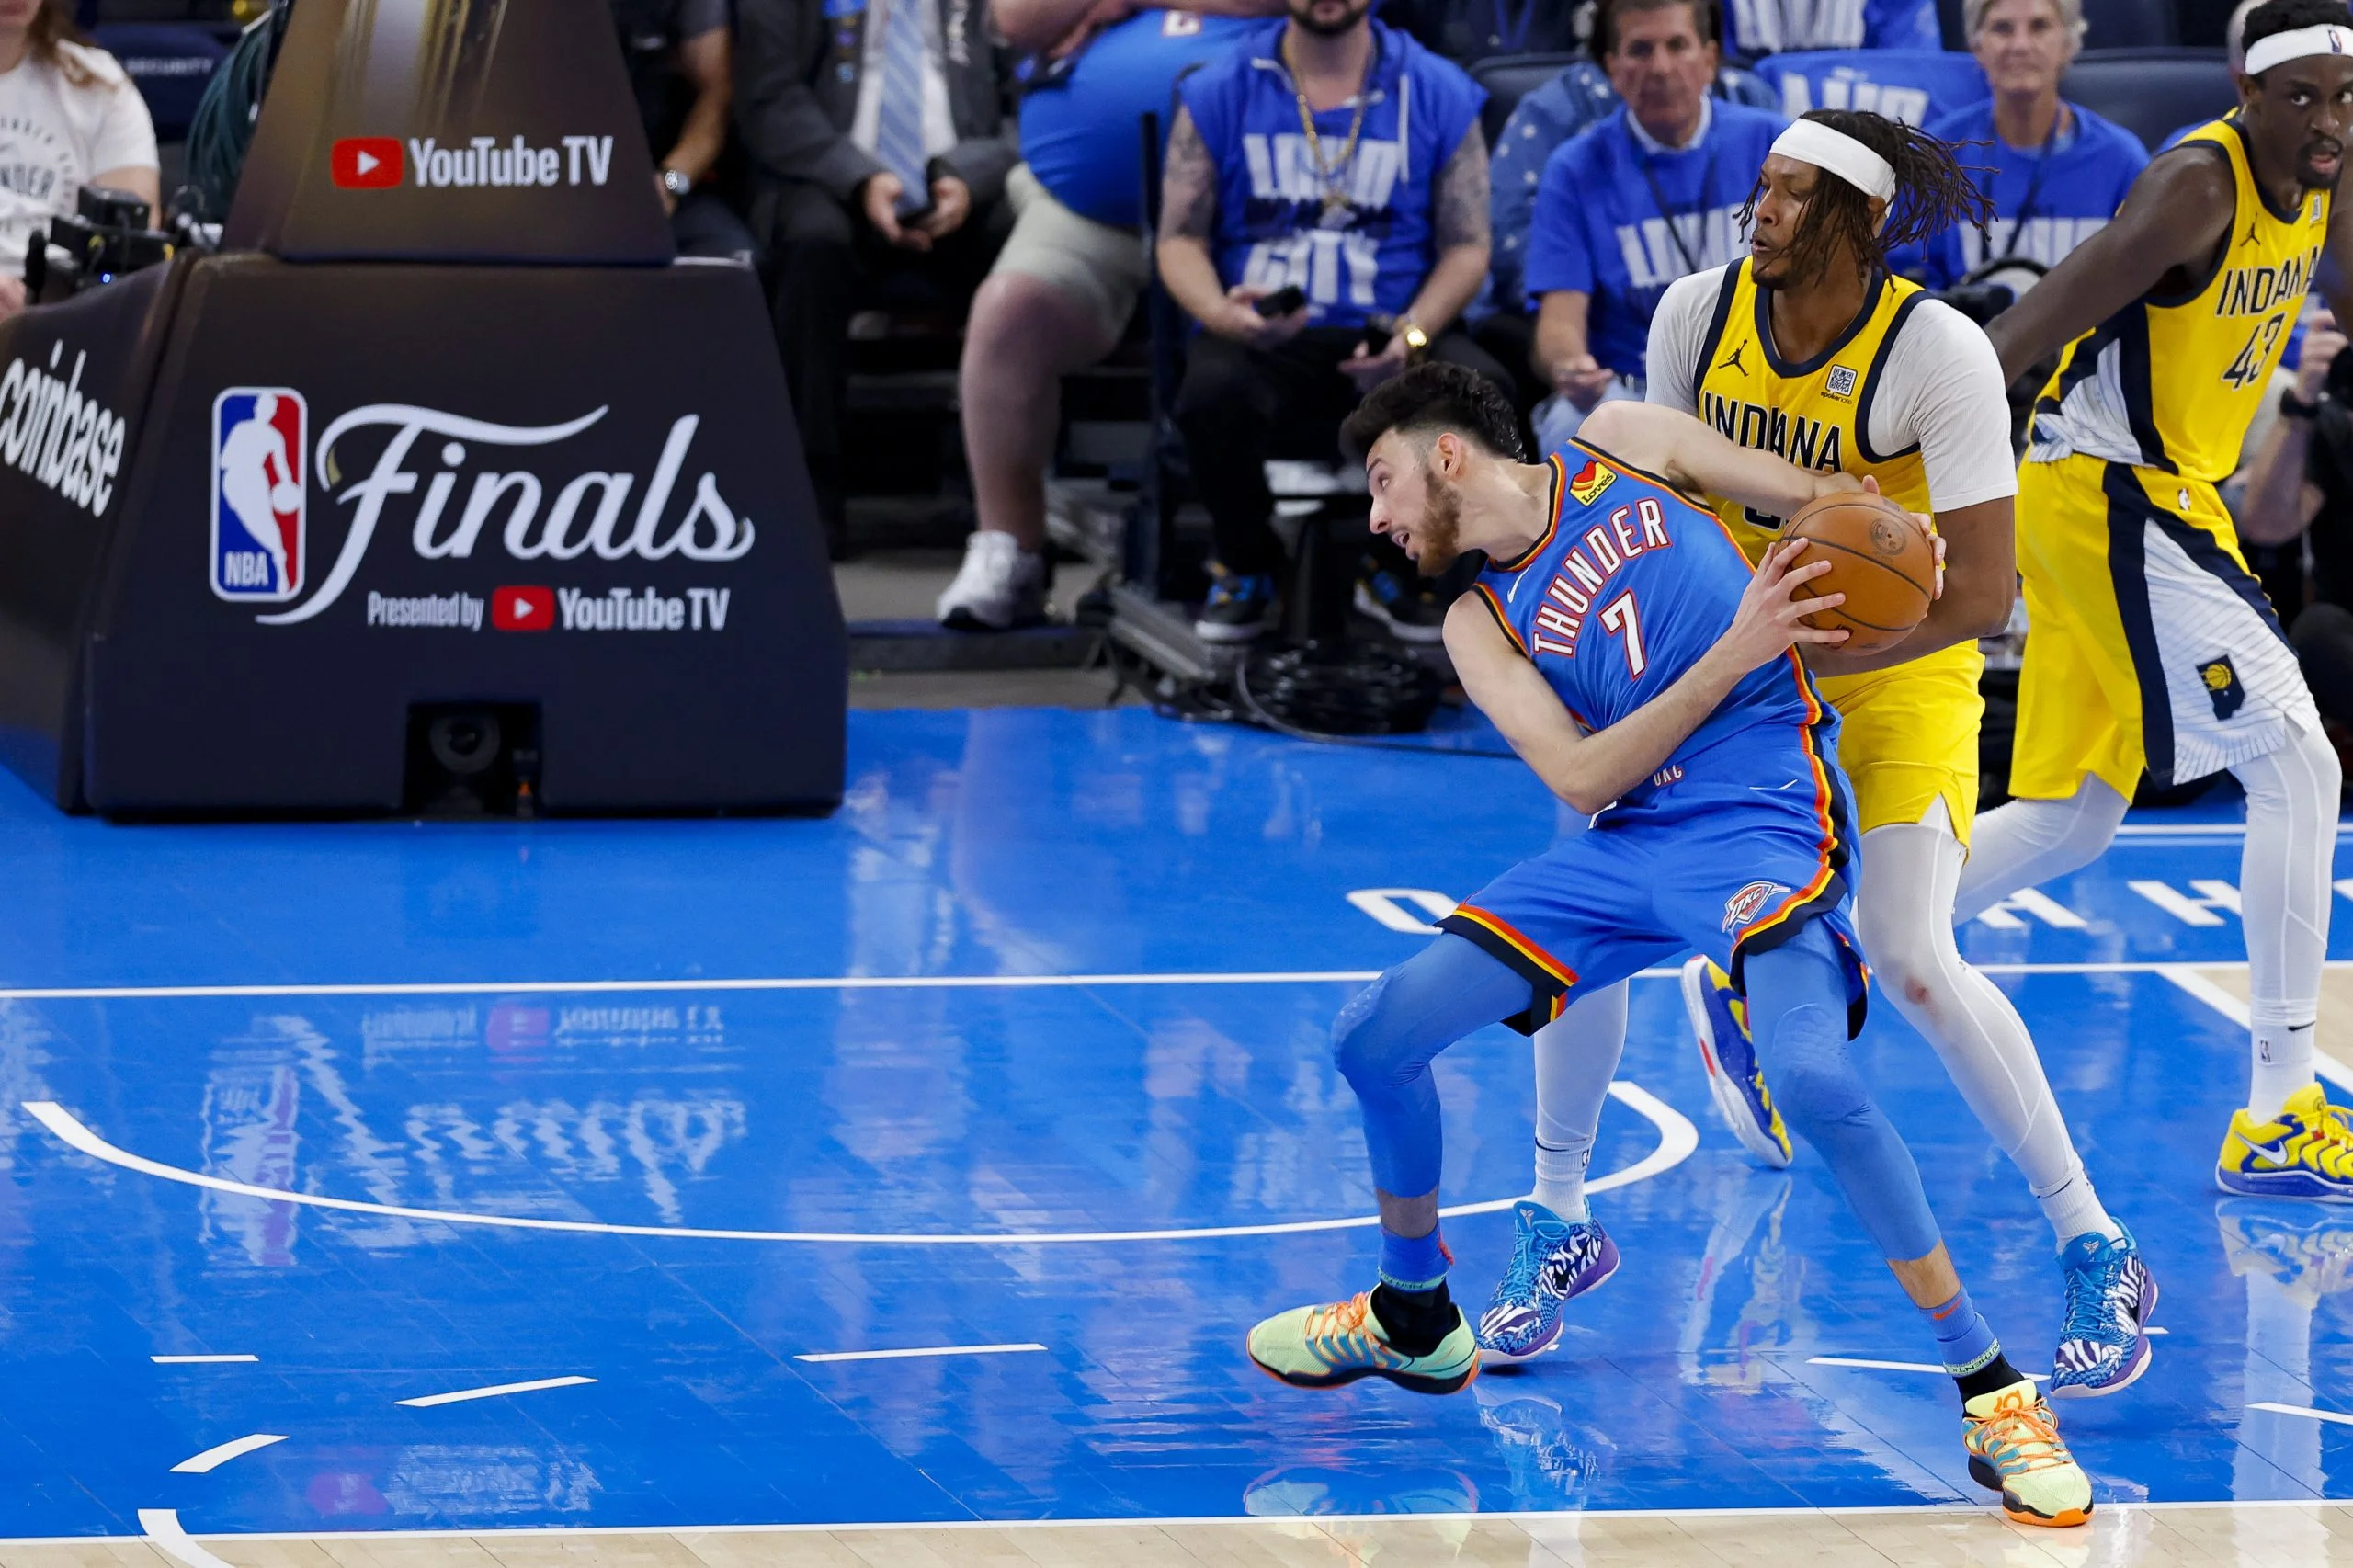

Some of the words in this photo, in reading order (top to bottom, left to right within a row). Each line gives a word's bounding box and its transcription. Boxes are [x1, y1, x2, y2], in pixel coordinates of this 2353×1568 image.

[408, 135, 559, 187] YouTube
[561, 135, 614, 186] TV
[2221, 312, 2286, 392] 43
[0, 338, 125, 517] coinbase
[255, 403, 756, 625] Finals
[224, 550, 269, 586] NBA
[368, 590, 459, 628] Presented
[460, 591, 485, 633] by
[557, 585, 686, 631] YouTube
[686, 586, 732, 631] TV
[1532, 496, 1672, 659] THUNDER
[1597, 587, 1648, 683] 7
